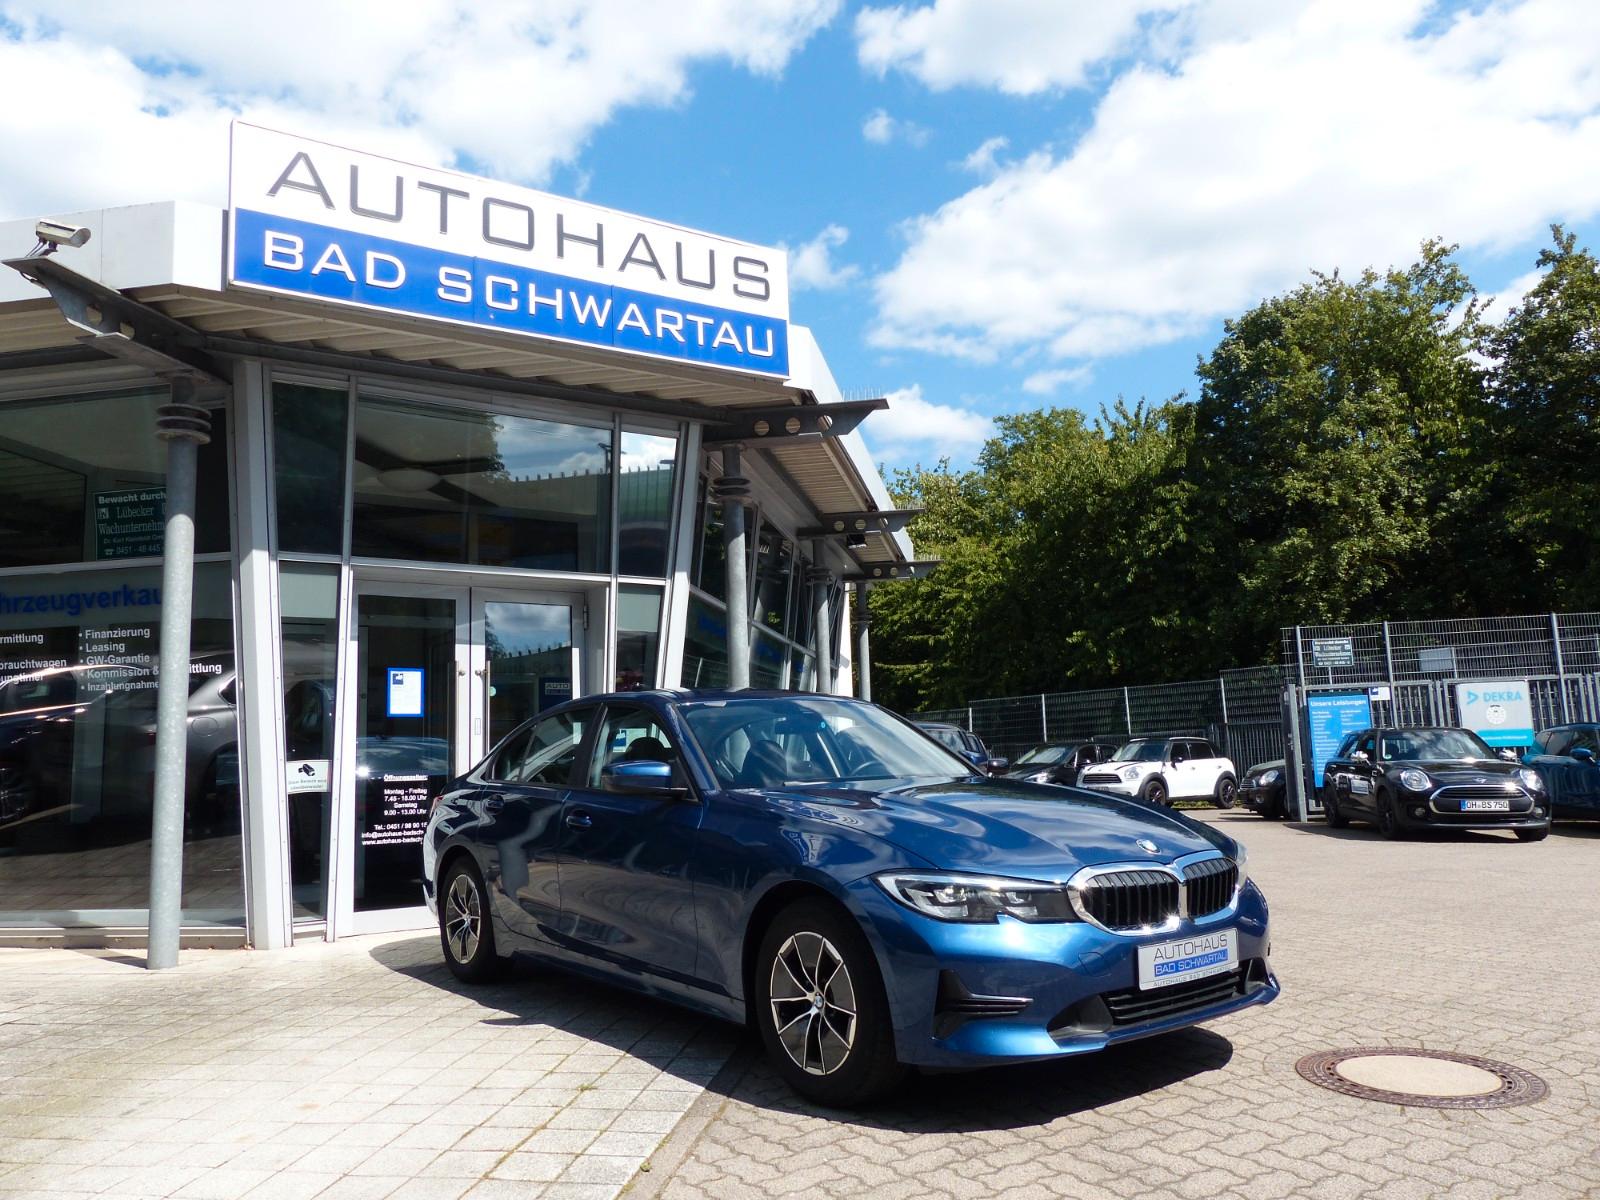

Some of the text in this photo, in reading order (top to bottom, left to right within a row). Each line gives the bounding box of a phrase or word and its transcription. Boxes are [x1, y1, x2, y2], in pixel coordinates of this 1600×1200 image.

[266, 152, 770, 302] AUTOHAUS
[264, 230, 774, 357] BAD SCHWARTAU
[98, 491, 167, 504] Bewacht durch
[0, 584, 161, 616] hrzeugverkau
[0, 633, 44, 645] rmittlung
[85, 628, 150, 639] Finanzierung
[85, 642, 125, 653] Leasing
[0, 659, 67, 670] brauchtwagen
[86, 653, 150, 665] GW-Garantie
[87, 663, 222, 679] Kommission & ittlung
[1483, 691, 1523, 702] DEKRA
[1466, 801, 1477, 809] OH
[1153, 934, 1228, 961] AUTOHAUS
[1155, 951, 1228, 975] BAD SCHWARTAU
